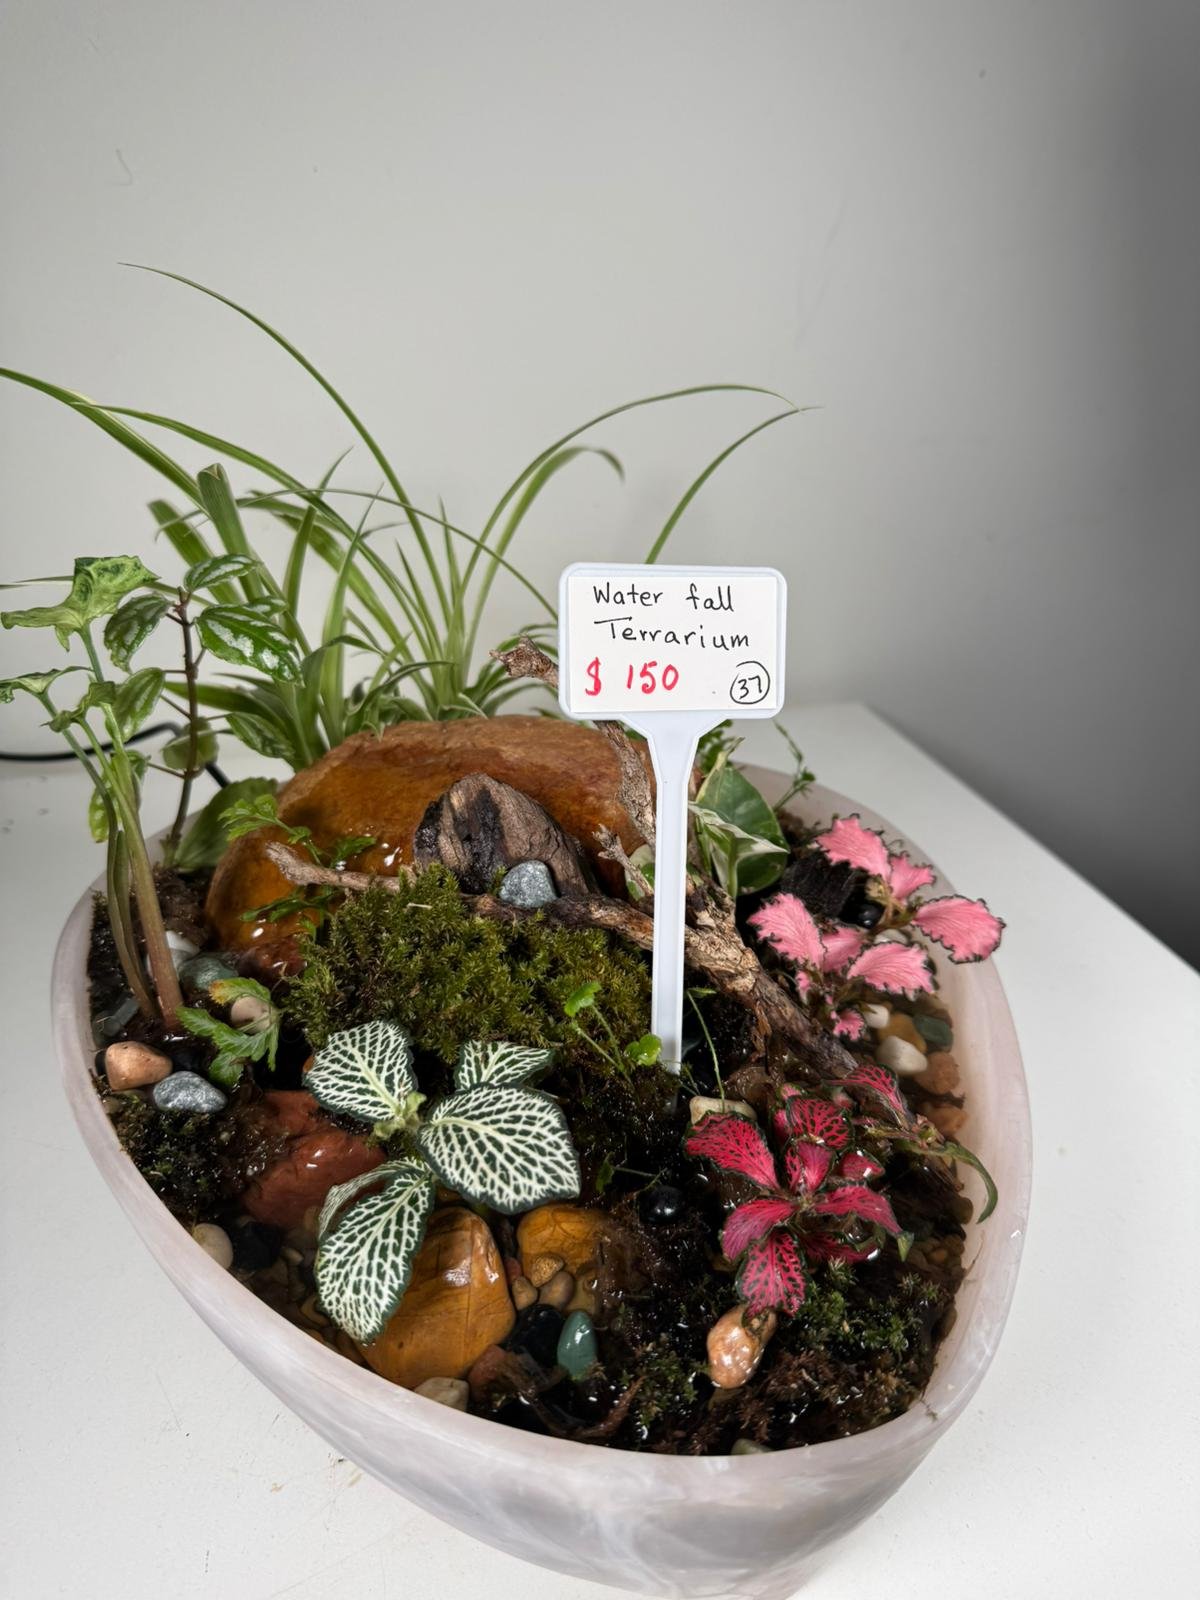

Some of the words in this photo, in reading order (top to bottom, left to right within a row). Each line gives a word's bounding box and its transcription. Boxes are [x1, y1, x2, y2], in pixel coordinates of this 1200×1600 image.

[592, 581, 664, 607] Water
[685, 582, 735, 612] fall
[594, 616, 750, 651] Terrarium
[626, 660, 680, 695] 150
